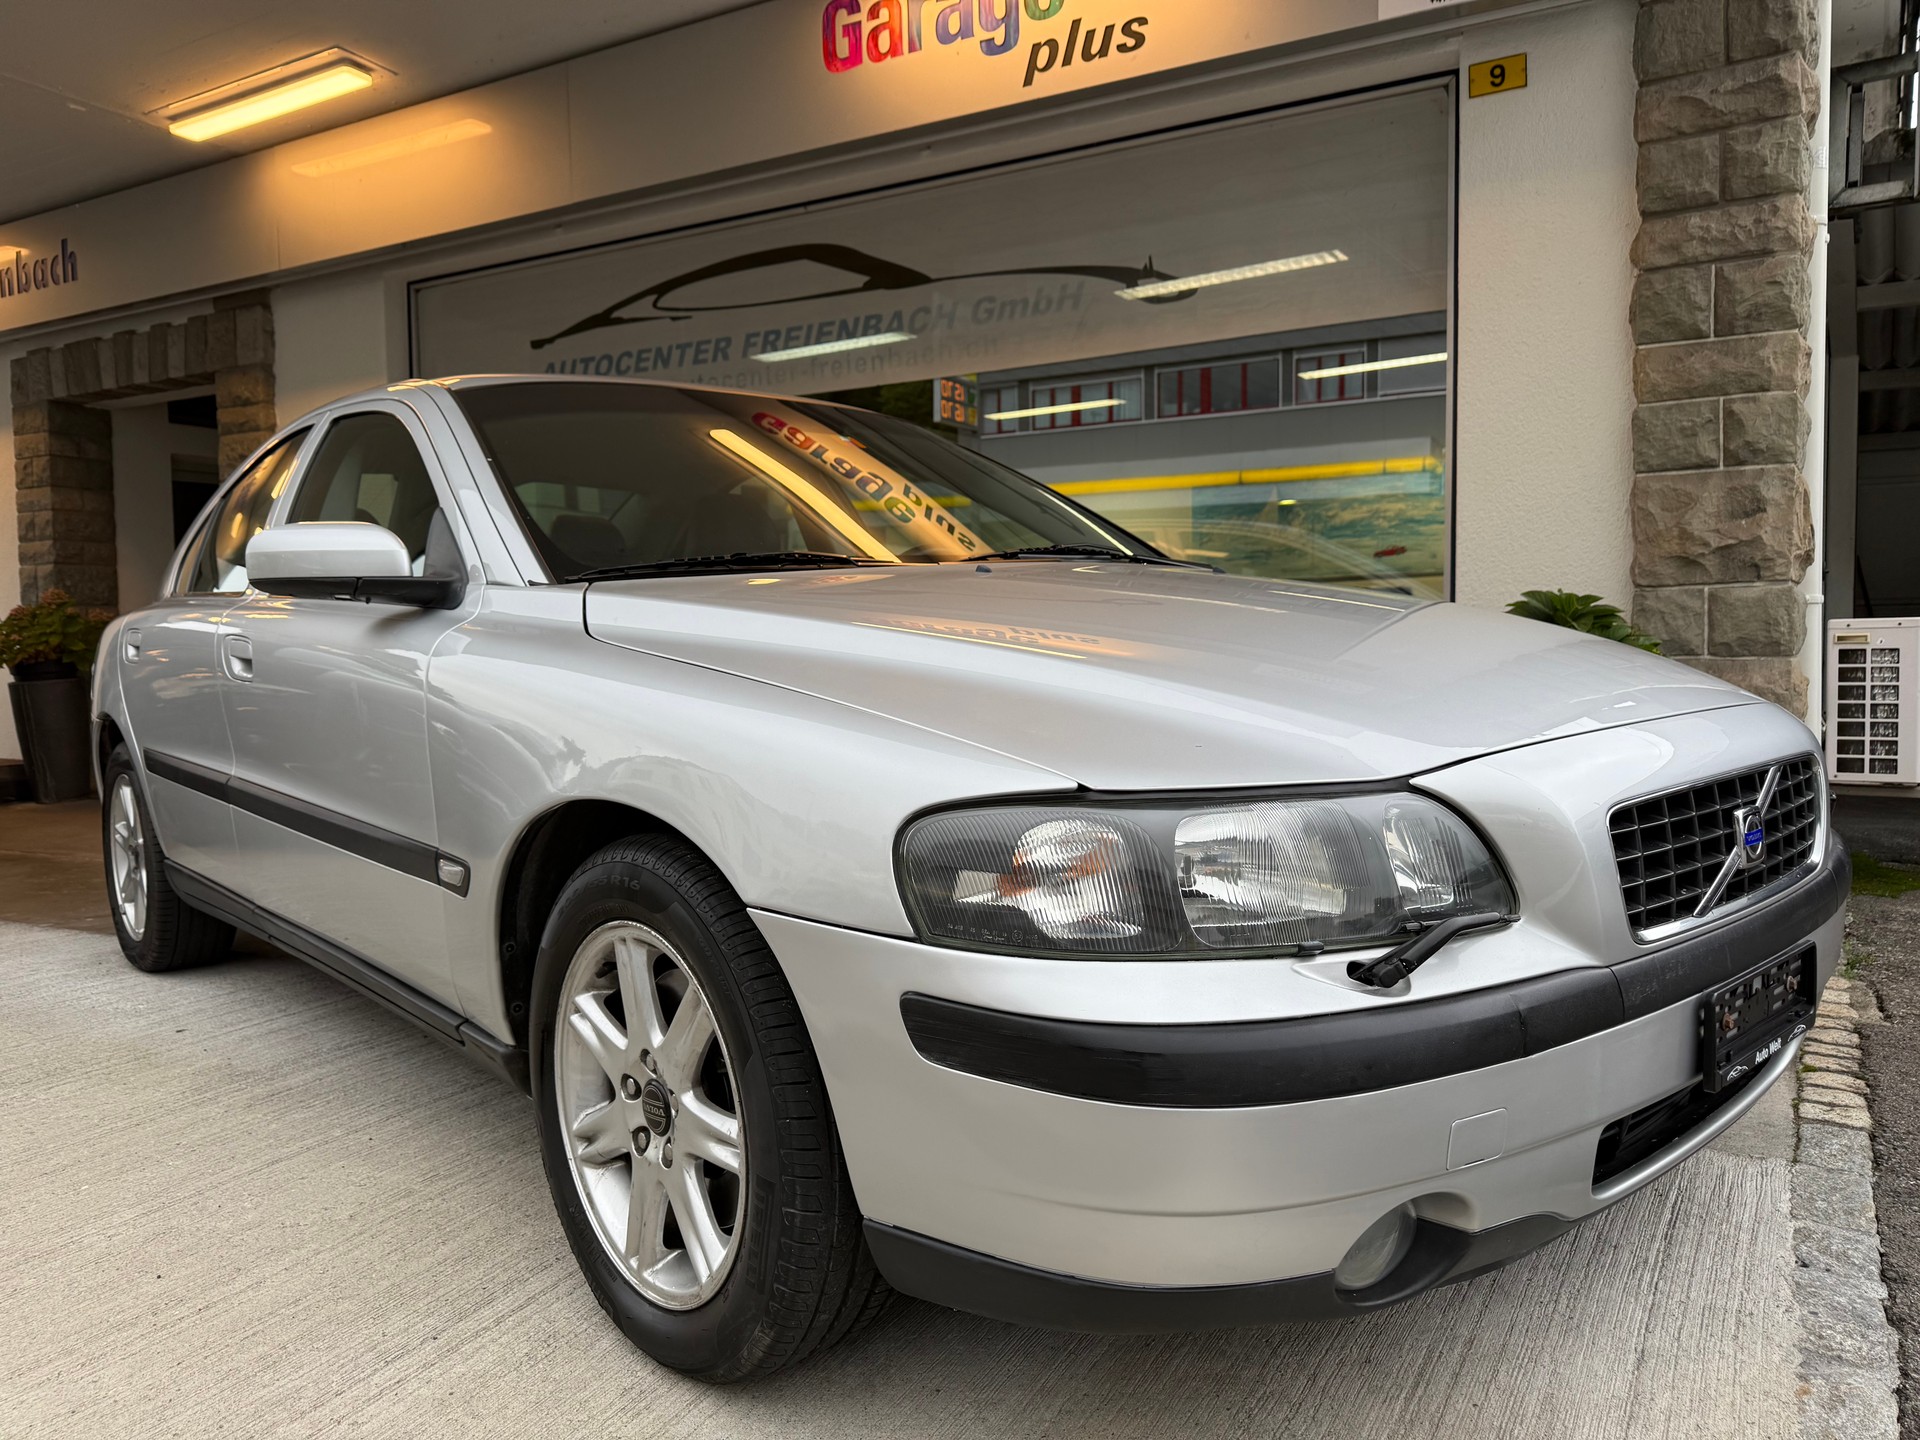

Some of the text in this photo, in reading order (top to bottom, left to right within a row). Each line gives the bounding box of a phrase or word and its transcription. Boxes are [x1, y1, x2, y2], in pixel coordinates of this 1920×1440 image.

[1022, 16, 1149, 88] plus
[1489, 64, 1506, 87] 9
[544, 281, 1086, 377] AUTOCENTER FREIENBACH GmbH
[1755, 1051, 1769, 1065] Auto
